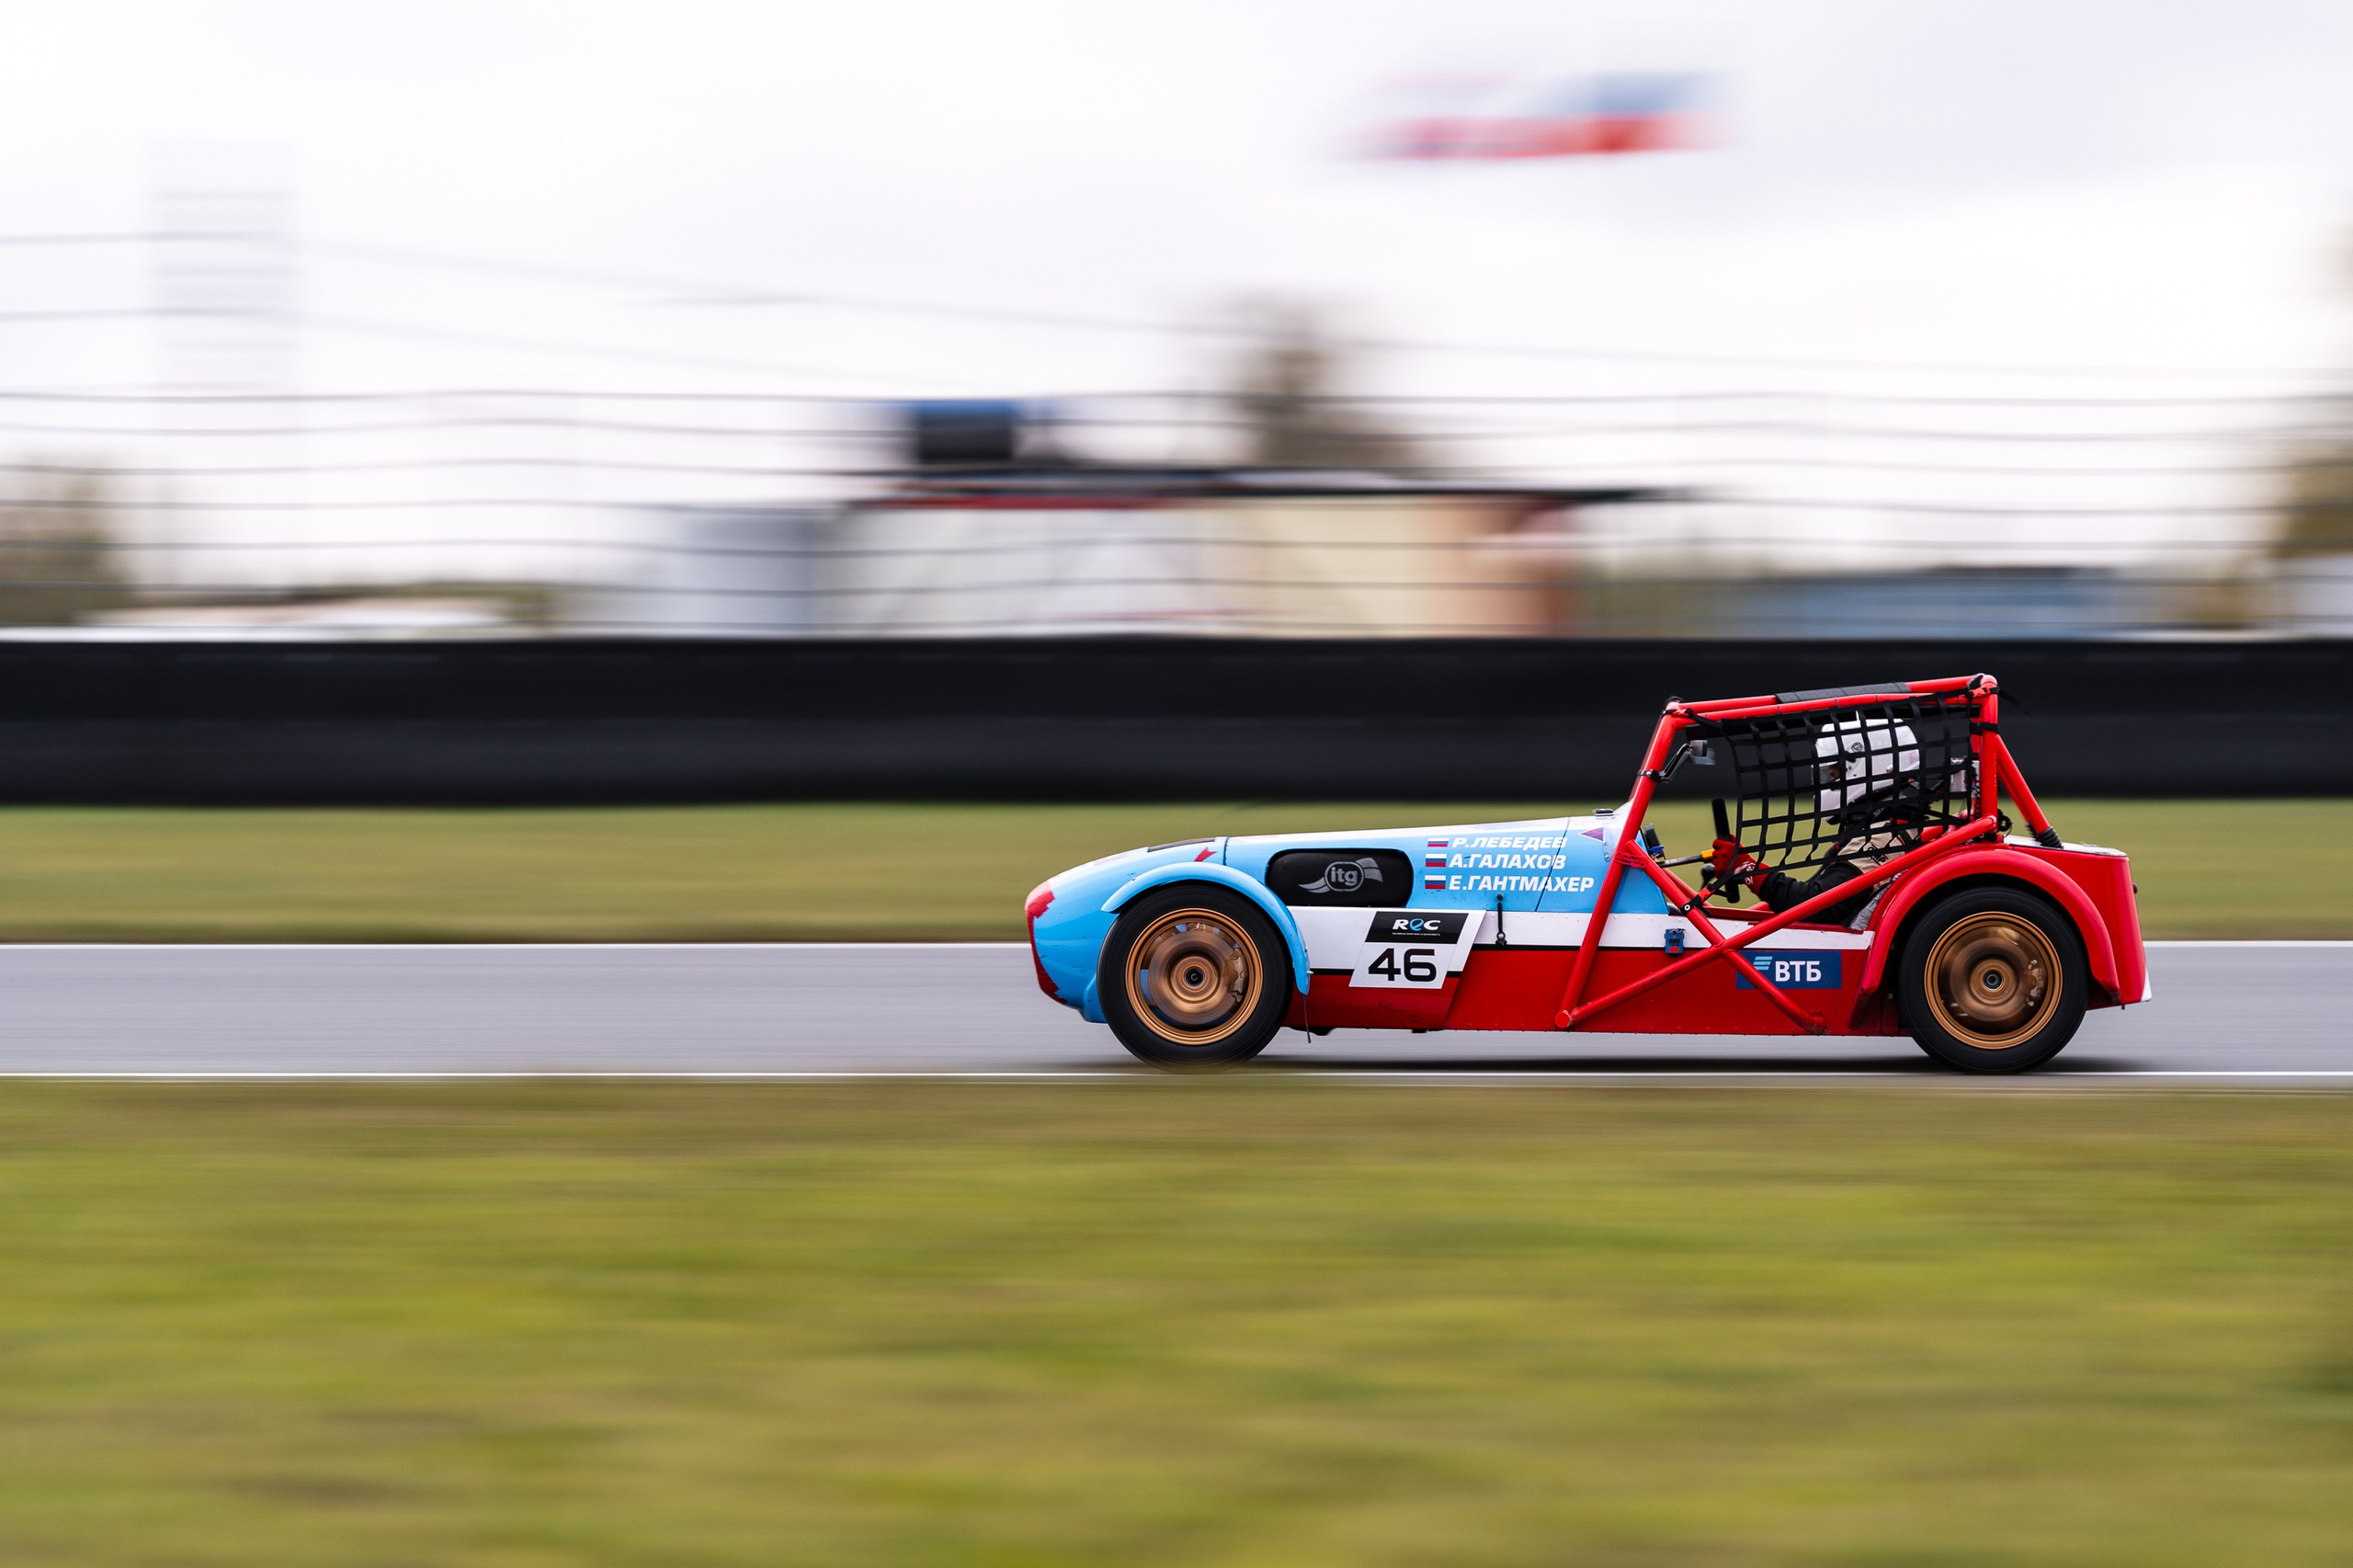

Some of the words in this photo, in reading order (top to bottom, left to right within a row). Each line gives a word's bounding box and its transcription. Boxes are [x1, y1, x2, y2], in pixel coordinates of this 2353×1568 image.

[1451, 836, 1568, 851] Р.ЛЕБЕДЕВ
[1449, 853, 1567, 869] А.ГАЛАХОВ
[1330, 866, 1358, 887] itg
[1449, 875, 1595, 892] Е.ГАНТМАХЕР
[1368, 948, 1437, 982] 46
[1775, 960, 1822, 982] ВТБ
